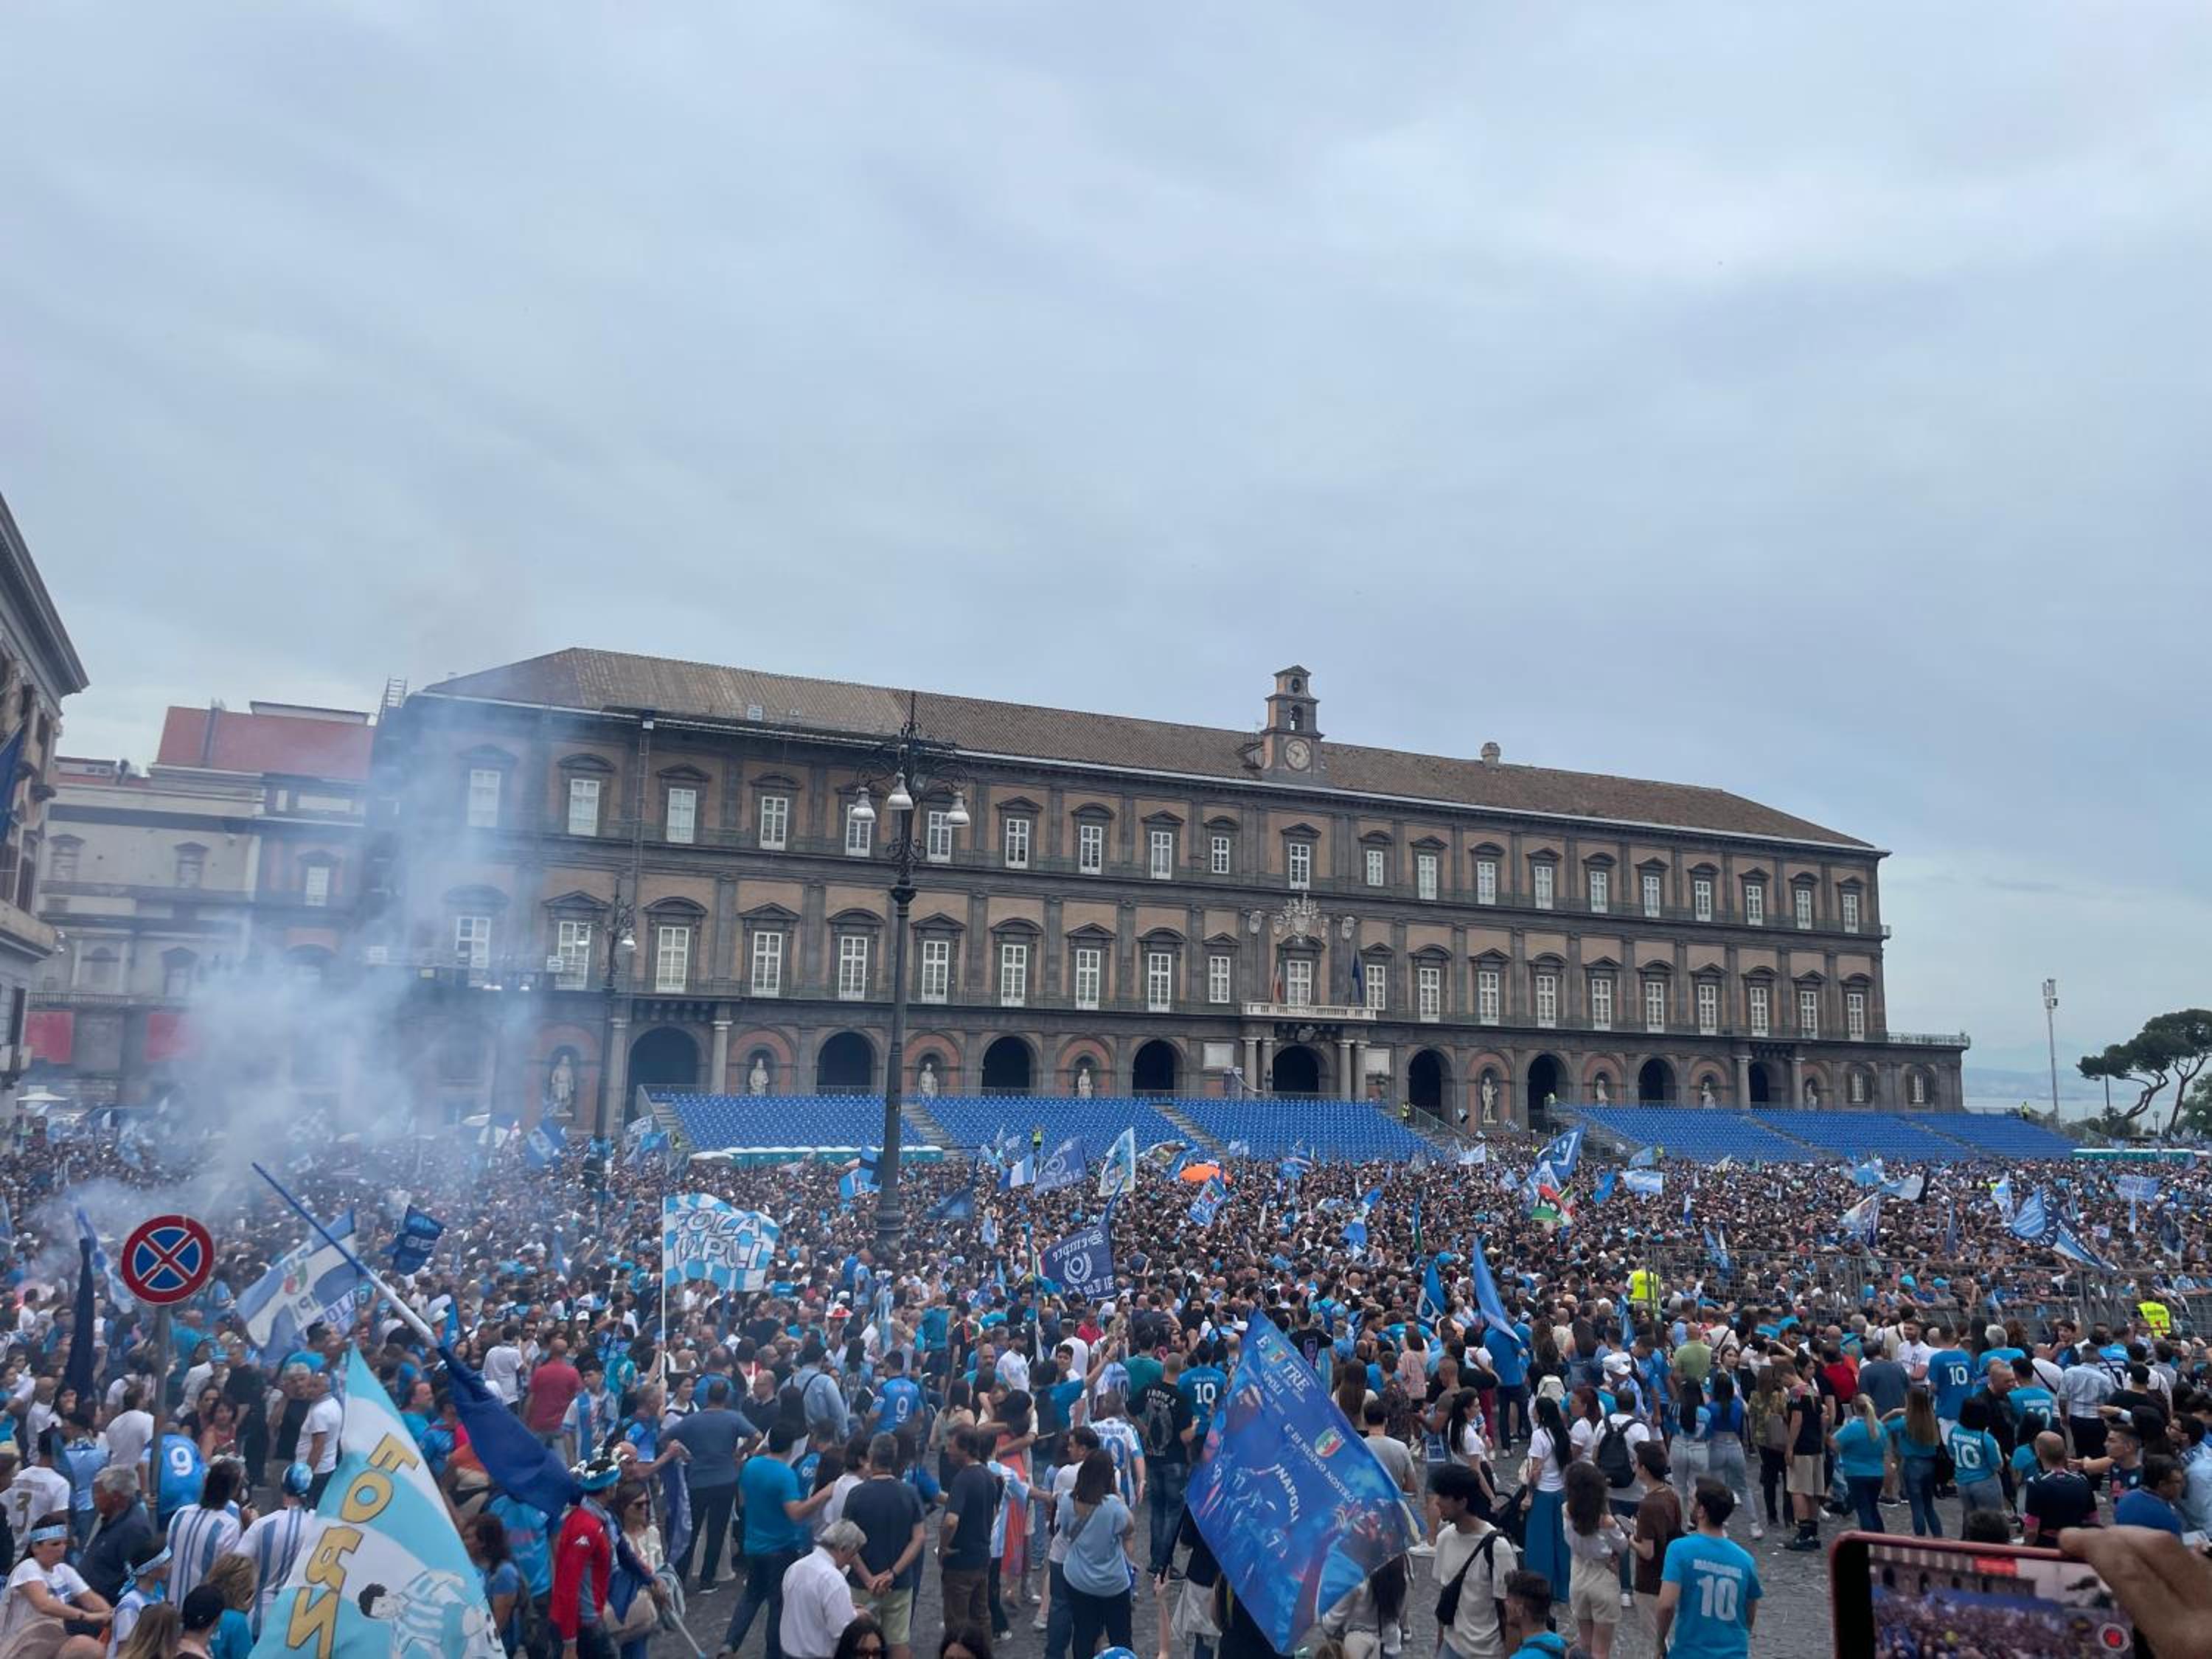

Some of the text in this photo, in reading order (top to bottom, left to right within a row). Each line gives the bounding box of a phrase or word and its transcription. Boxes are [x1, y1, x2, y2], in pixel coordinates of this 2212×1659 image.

[1949, 1366, 1968, 1385] 10
[1194, 1382, 1217, 1405] 10
[170, 1446, 193, 1475] 9
[1952, 1441, 1981, 1470] 10
[1697, 1574, 1738, 1621] 10
